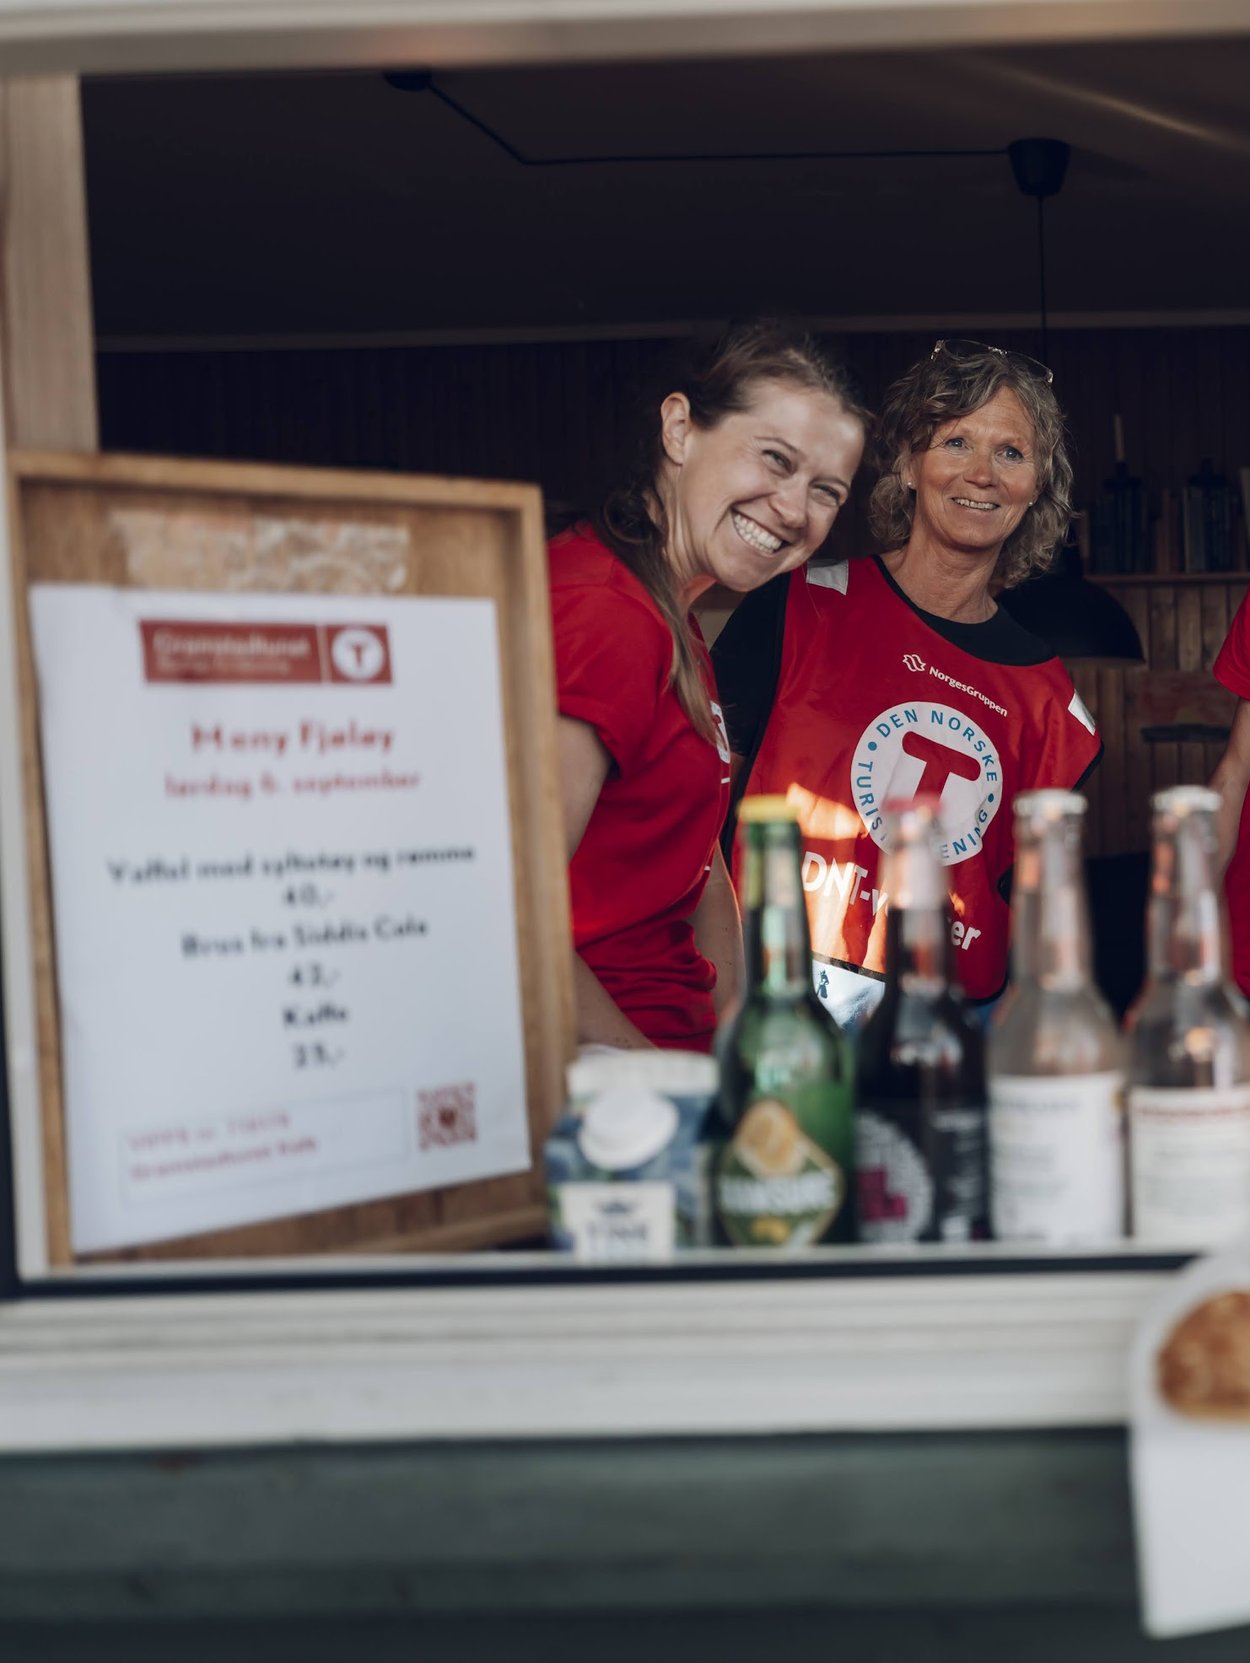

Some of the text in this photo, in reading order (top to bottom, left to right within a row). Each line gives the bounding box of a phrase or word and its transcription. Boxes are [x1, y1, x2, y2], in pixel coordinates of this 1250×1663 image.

[928, 666, 1009, 717] NorgesGruppen
[875, 708, 998, 783] DEN NORSKE
[198, 853, 254, 879] med
[283, 1003, 349, 1029] Kaffe
